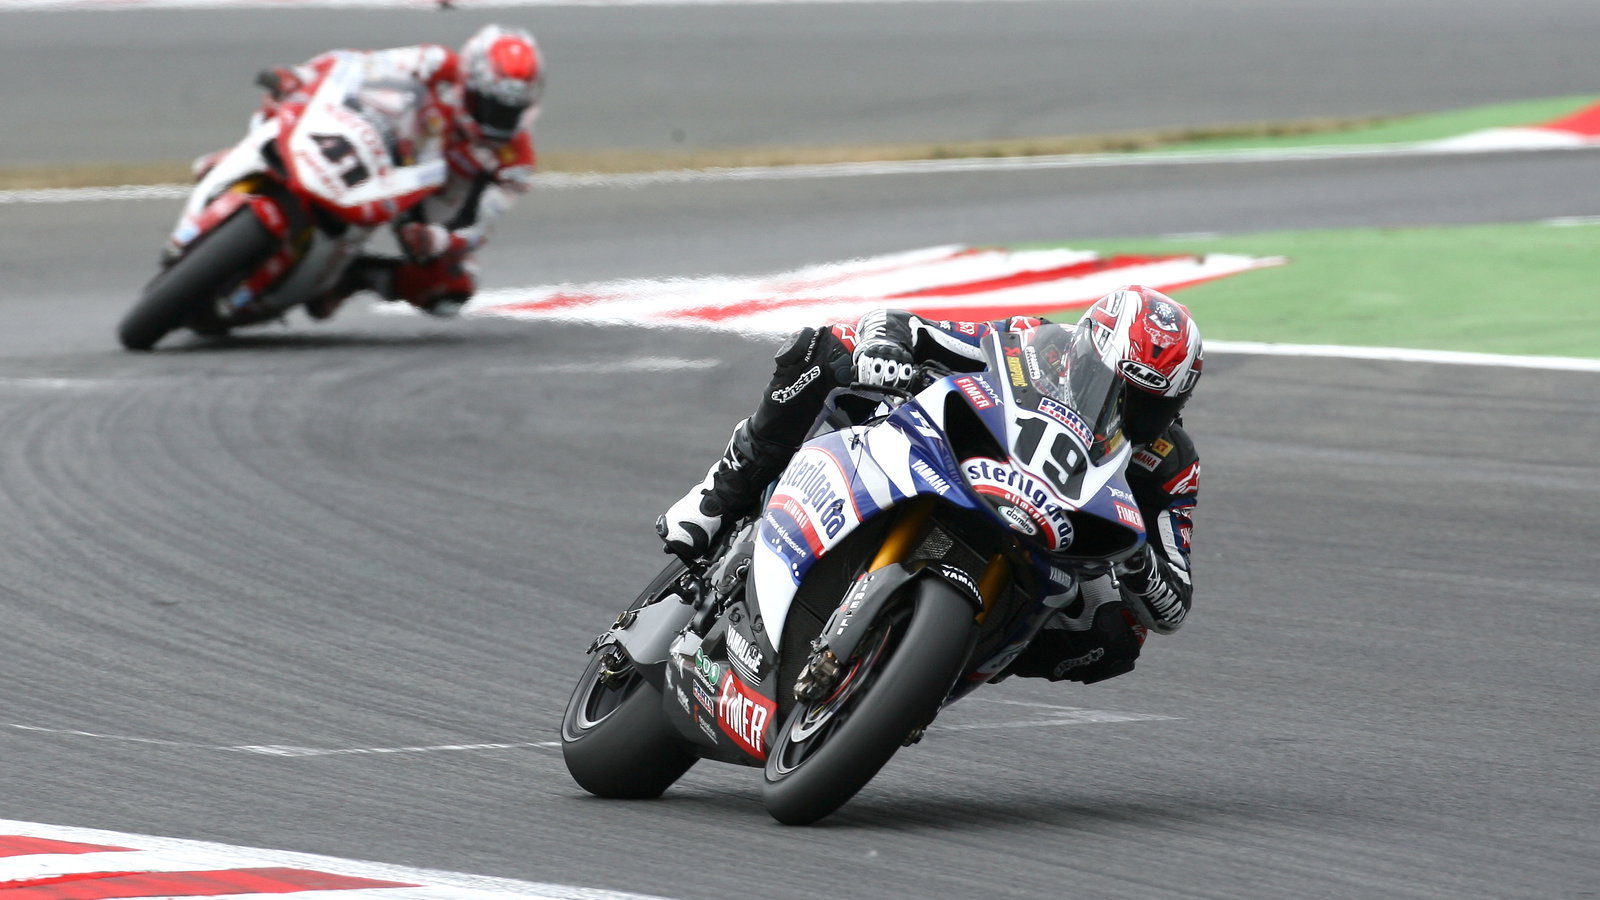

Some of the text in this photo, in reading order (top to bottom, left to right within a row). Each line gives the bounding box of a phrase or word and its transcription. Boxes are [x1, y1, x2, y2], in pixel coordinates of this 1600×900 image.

[308, 133, 370, 189] 41
[1123, 363, 1165, 386] HJC
[957, 378, 990, 408] FIMER
[1041, 399, 1094, 441] PARTS
[1014, 416, 1088, 501] 19
[911, 459, 950, 495] YAMAHA
[967, 461, 1072, 549] sterilgarda
[1004, 493, 1048, 526] alimenti
[1006, 506, 1034, 534] domino
[1115, 504, 1143, 528] FIMER
[942, 569, 983, 605] YAMAHA
[1146, 573, 1187, 624] YAMAH
[719, 674, 768, 753] FIMER
